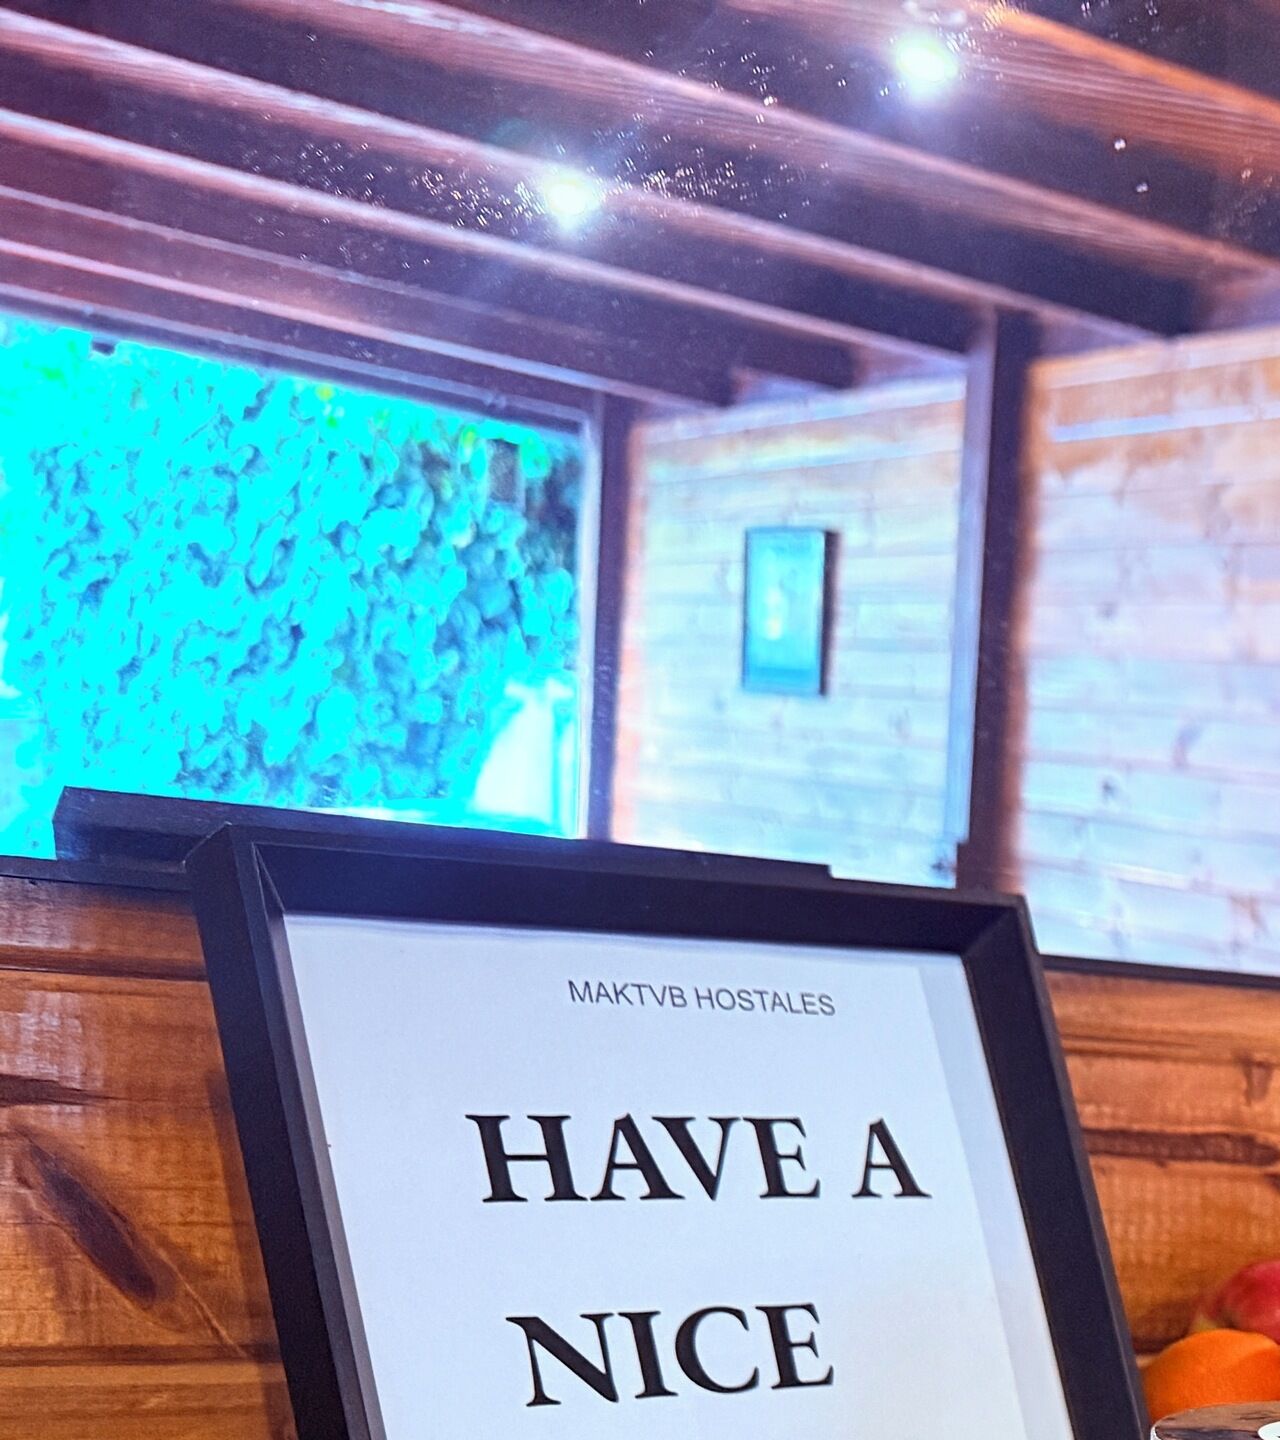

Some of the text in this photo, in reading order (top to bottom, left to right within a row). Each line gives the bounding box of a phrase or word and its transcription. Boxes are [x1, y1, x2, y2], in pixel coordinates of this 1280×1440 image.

[567, 979, 836, 1016] MAKTVB HOSTALES
[465, 1112, 933, 1202] HAVE A
[505, 1303, 834, 1407] NICE
